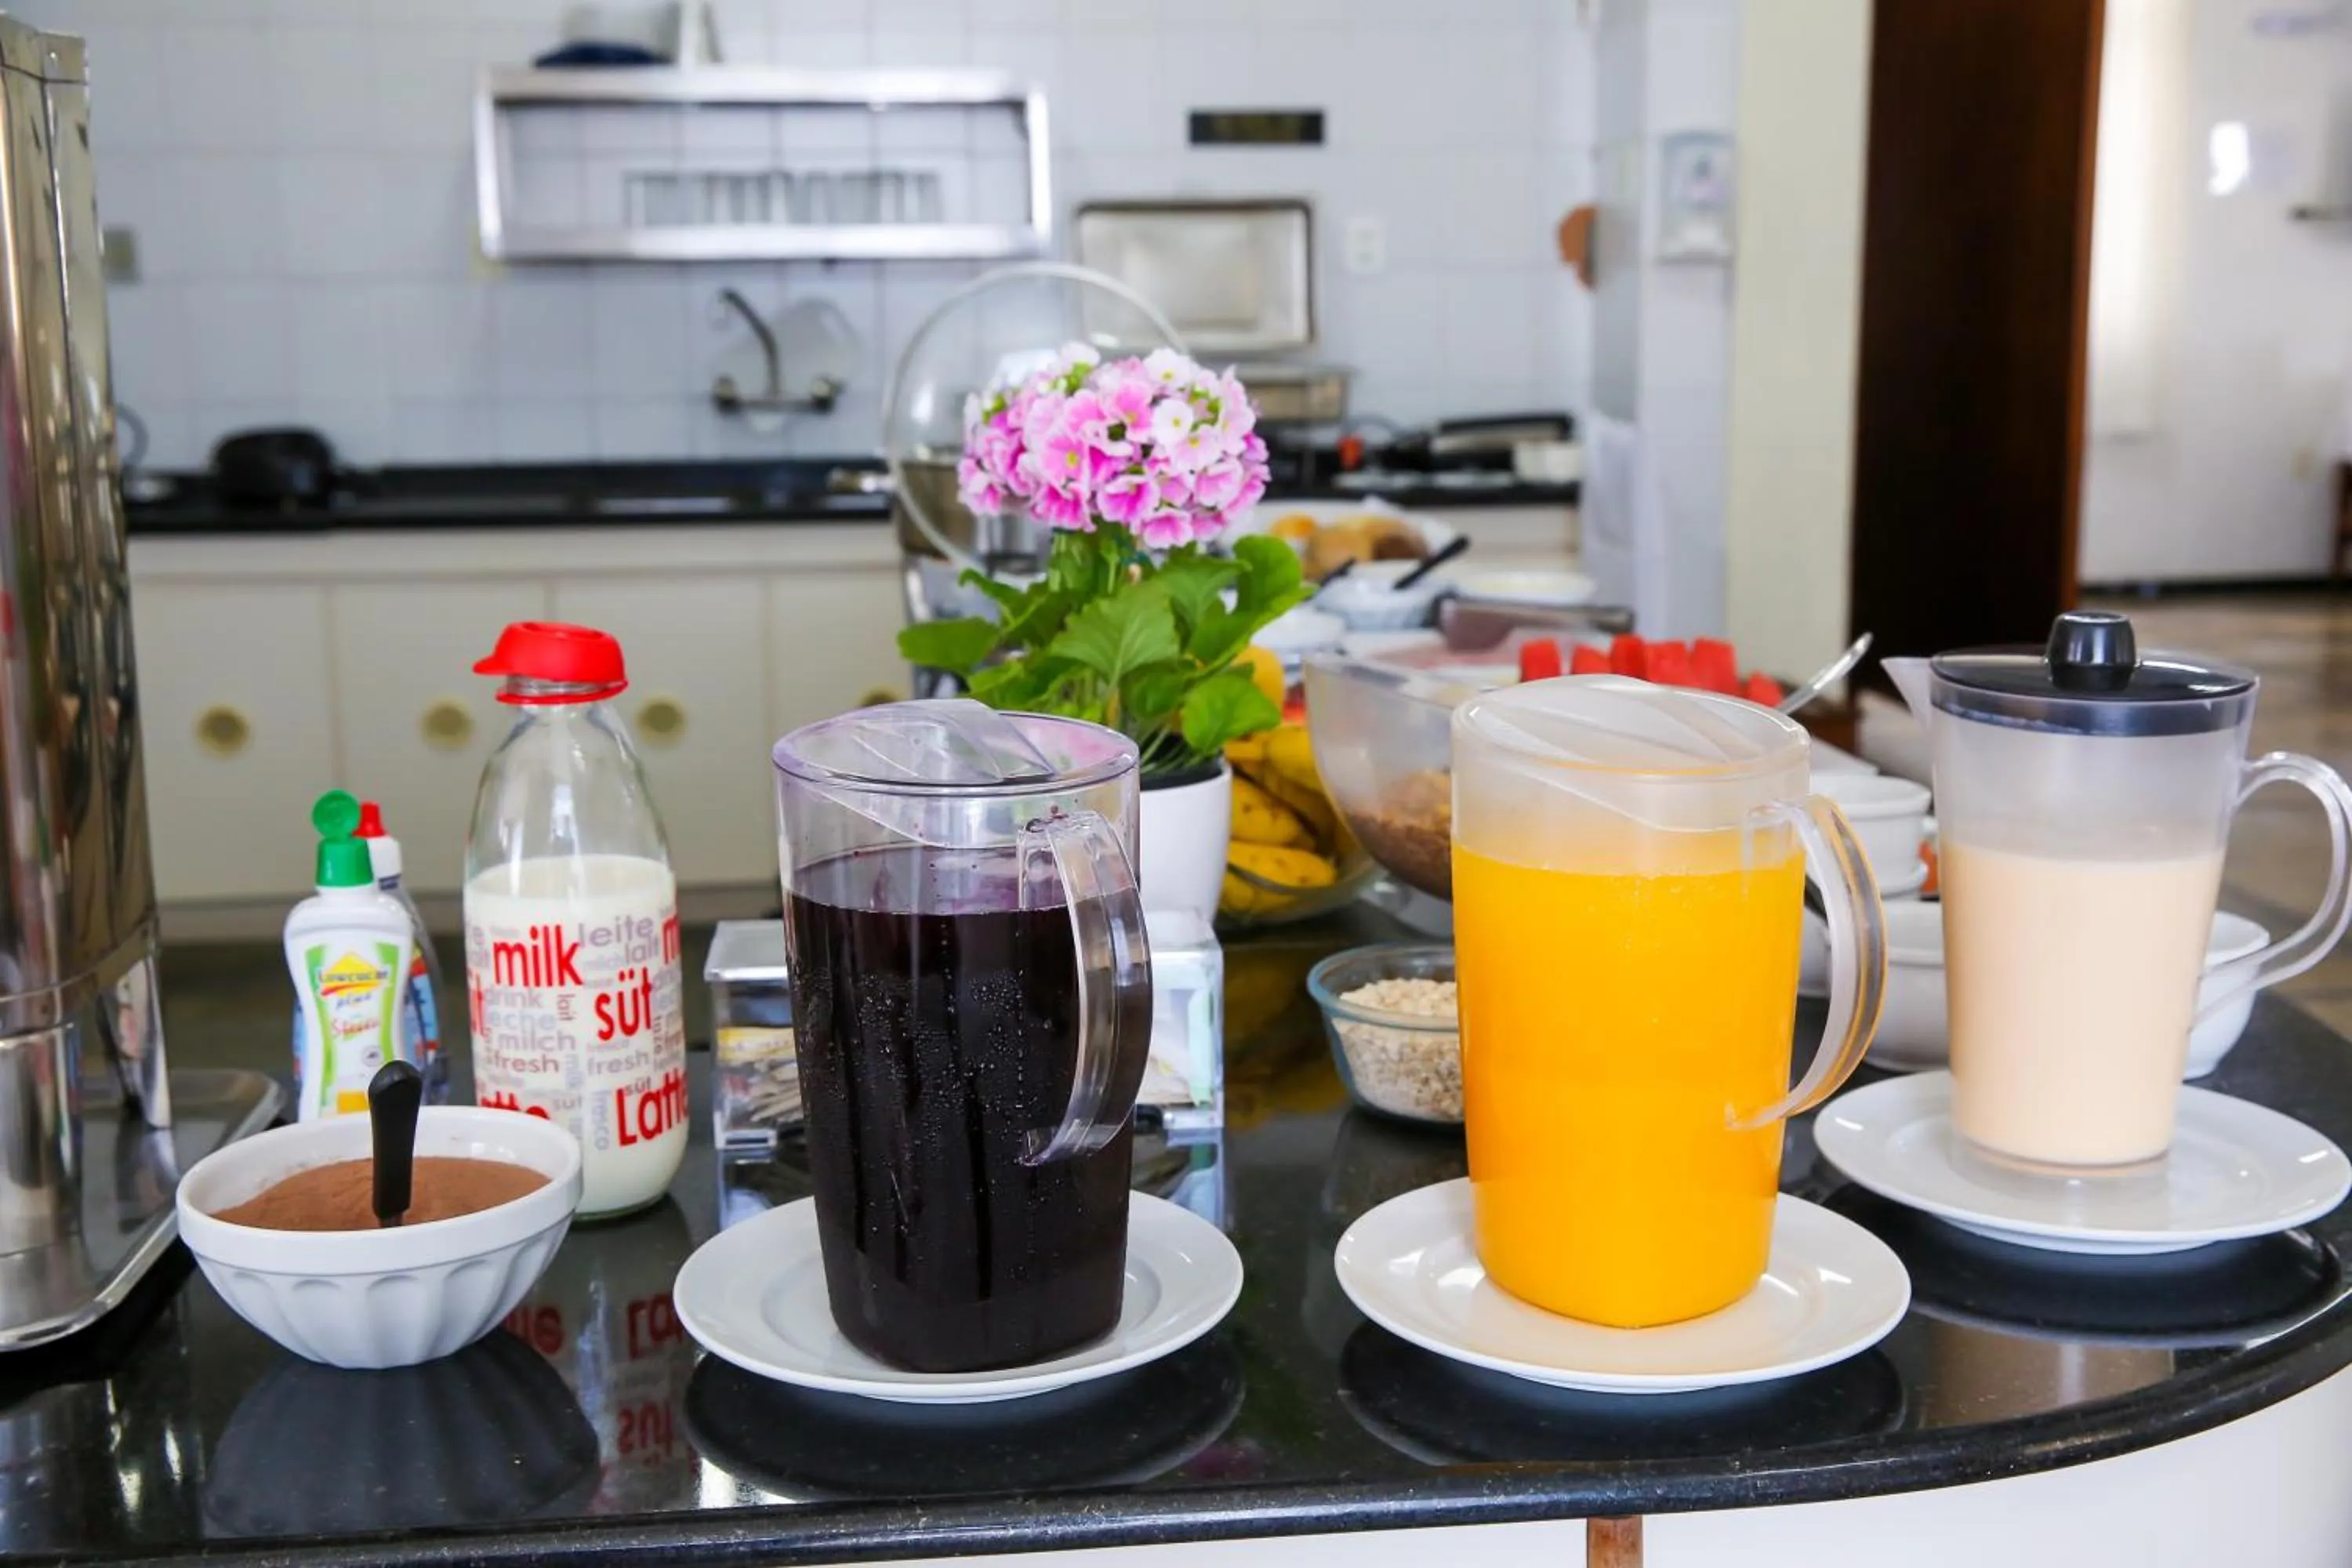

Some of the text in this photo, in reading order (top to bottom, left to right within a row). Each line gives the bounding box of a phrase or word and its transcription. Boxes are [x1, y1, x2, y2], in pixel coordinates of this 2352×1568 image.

[579, 915, 653, 948] leite
[493, 924, 583, 988] milk
[594, 967, 652, 1041] süt
[497, 1028, 576, 1052] milch
[493, 1049, 560, 1073] fresh
[587, 1049, 649, 1076] fresh
